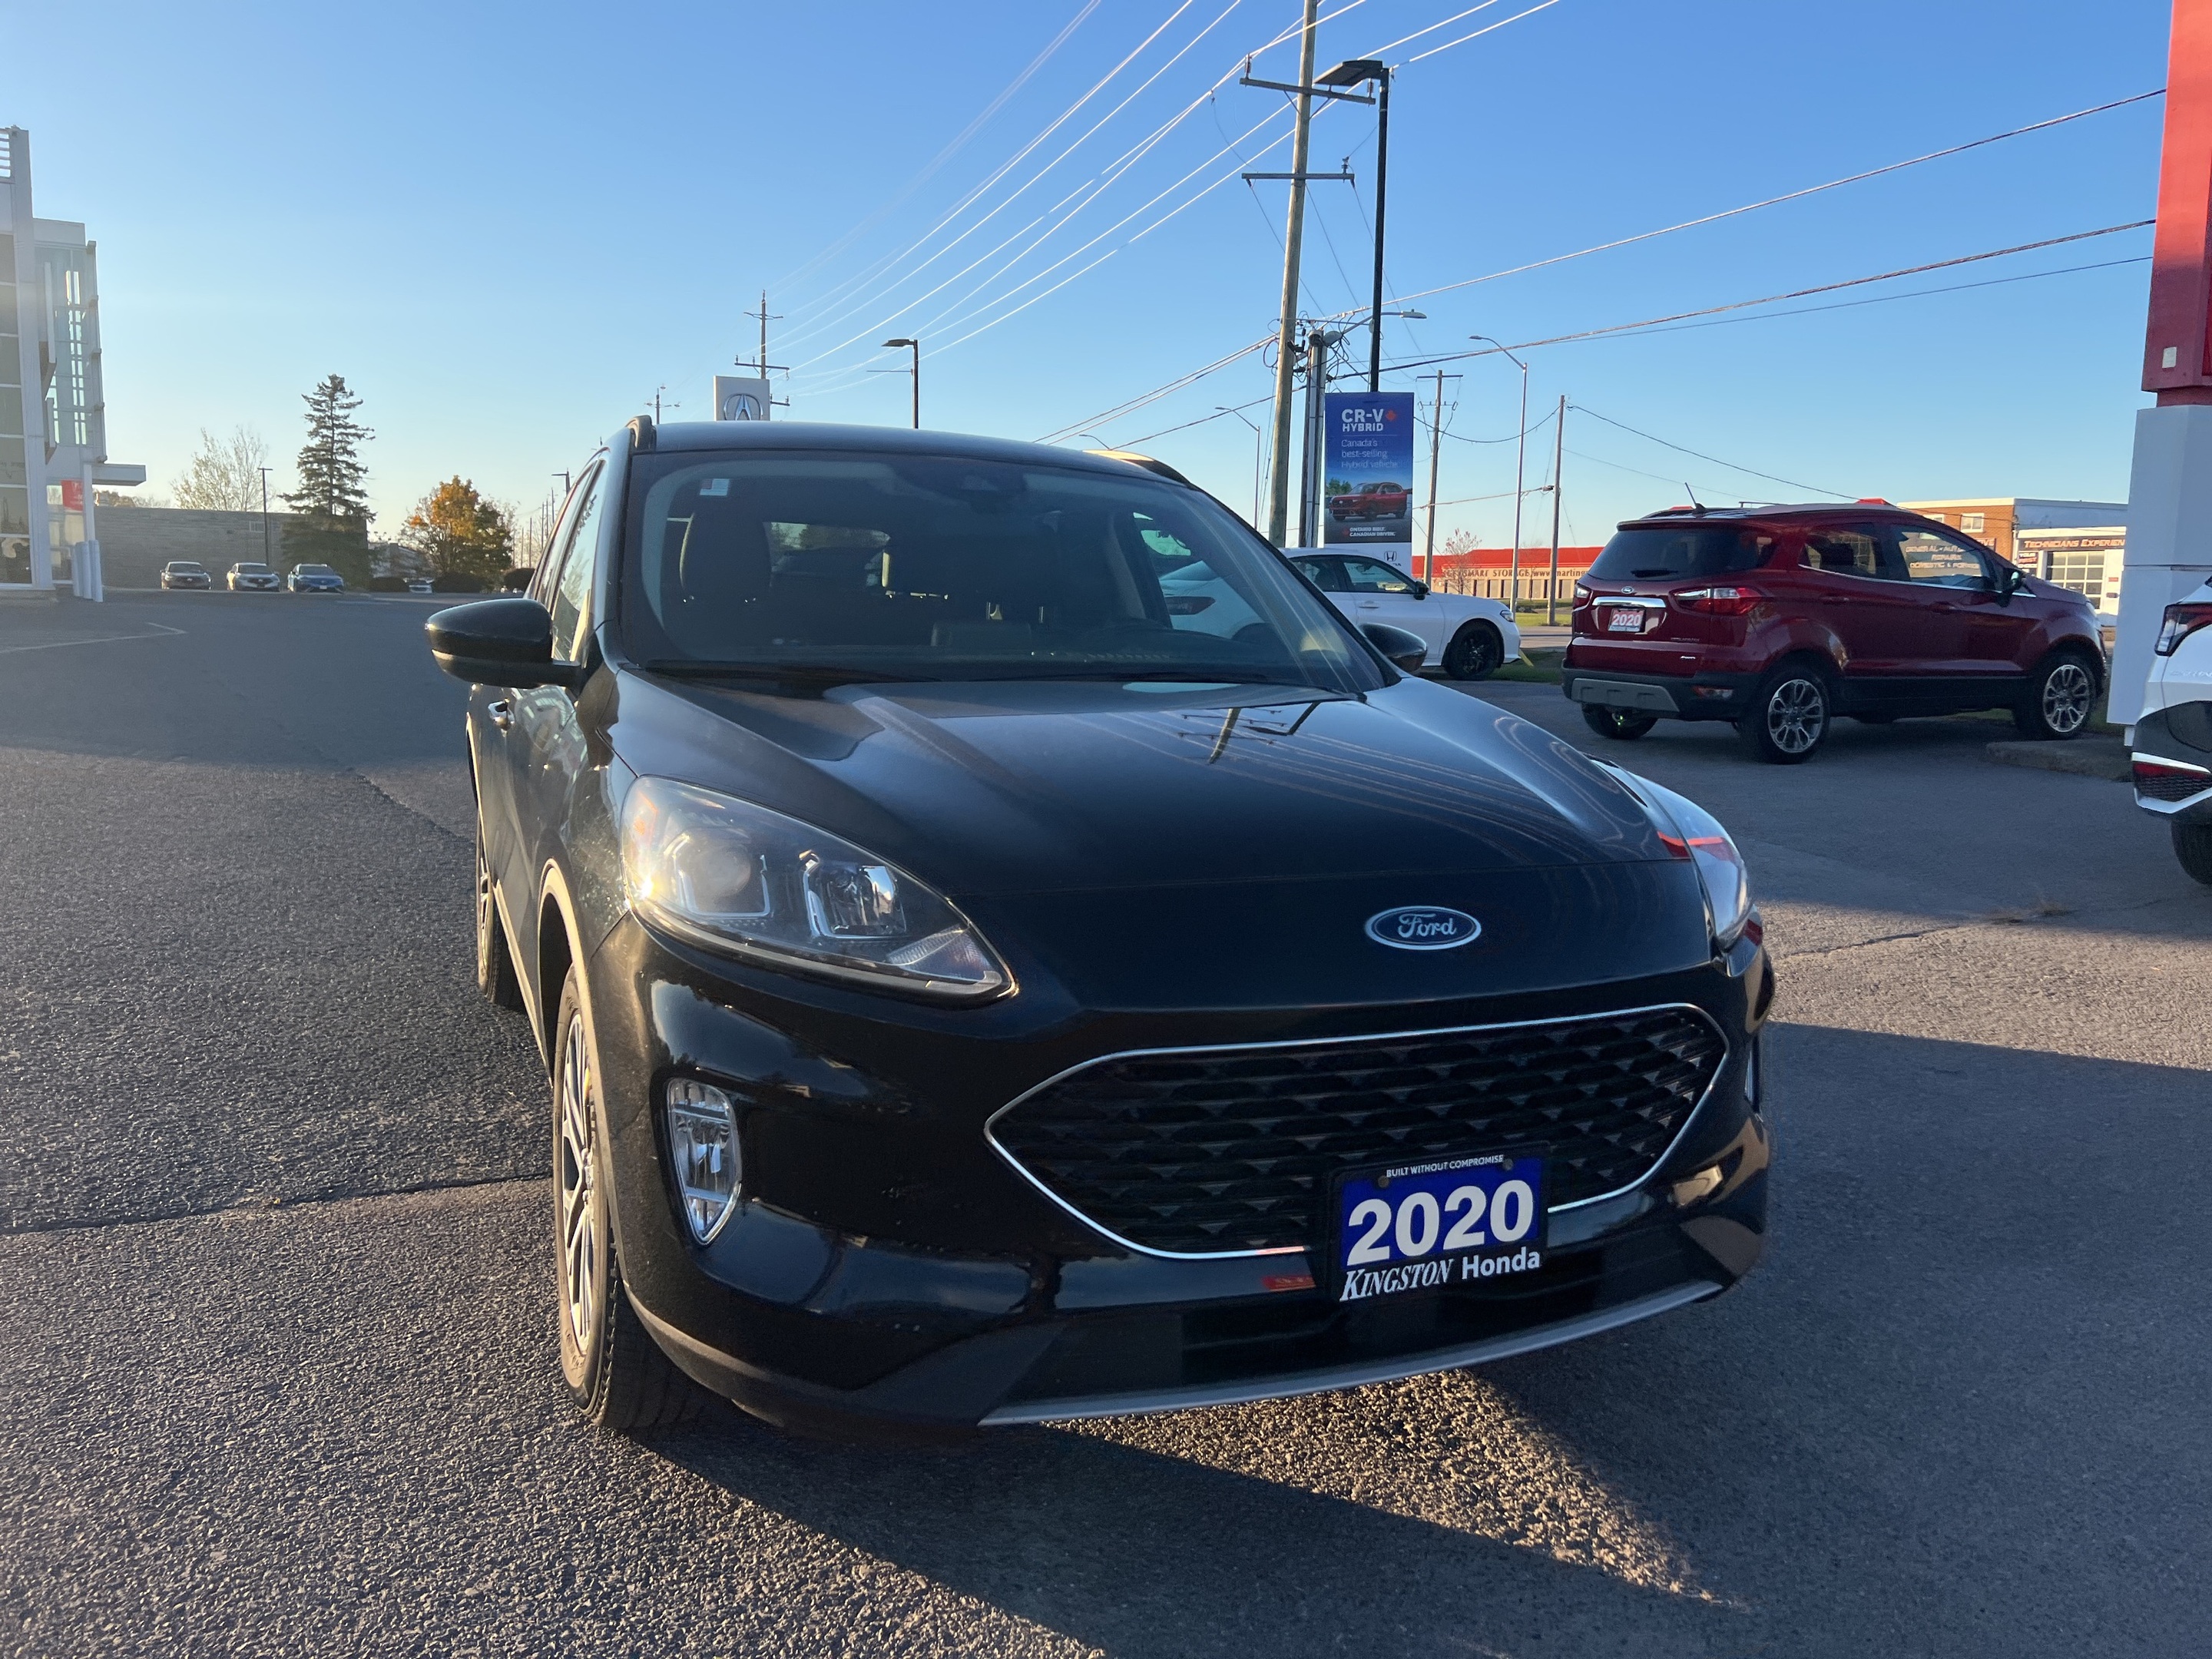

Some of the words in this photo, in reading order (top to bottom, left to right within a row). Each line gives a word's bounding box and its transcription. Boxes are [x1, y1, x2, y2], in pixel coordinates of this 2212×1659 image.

[1341, 409, 1384, 422] CR-V
[1342, 422, 1383, 432] HYBRID
[1341, 439, 1378, 447] Canada's
[1341, 449, 1388, 459] best-selling
[1611, 614, 1641, 627] 2020
[1398, 913, 1457, 938] Ford
[1386, 1166, 1409, 1177] BUILT
[1410, 1161, 1448, 1175] WITHOUT
[1449, 1154, 1504, 1169] COMPROMISE
[1347, 1180, 1534, 1267] 2020
[1339, 1258, 1455, 1302] KINGSTON
[1462, 1247, 1541, 1280] Honda
